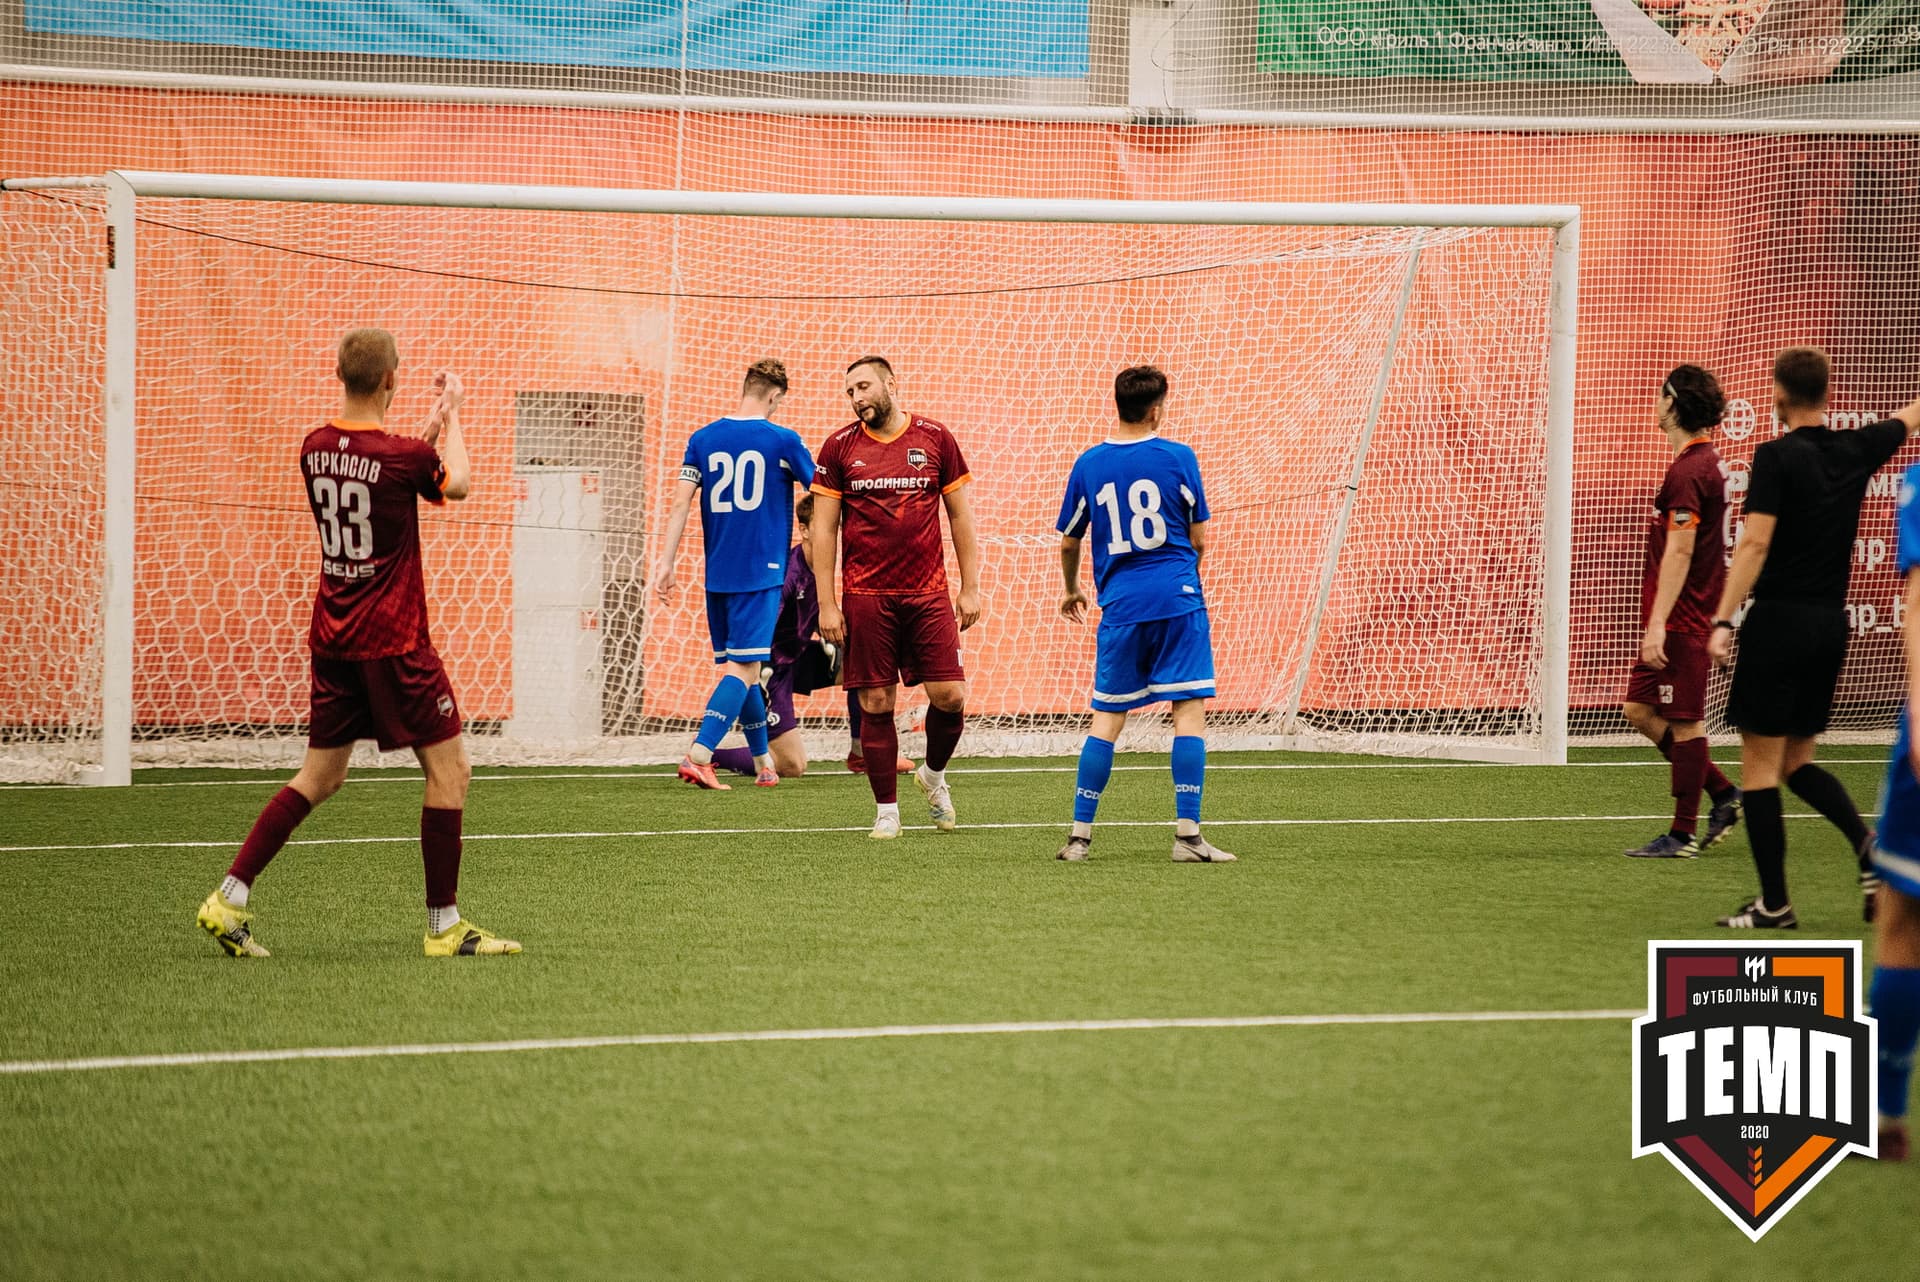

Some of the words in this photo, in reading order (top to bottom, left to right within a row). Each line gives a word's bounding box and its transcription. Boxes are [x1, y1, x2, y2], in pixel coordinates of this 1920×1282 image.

[1318, 26, 1365, 45] ООО
[306, 451, 382, 484] ЧЕРКАСОВ
[708, 450, 766, 513] 20
[850, 477, 931, 491] ПРОДИНВЕСТ
[312, 476, 374, 561] 33
[1095, 478, 1168, 556] 18
[323, 560, 376, 578] SEUS
[1076, 787, 1101, 800] FCD
[1175, 783, 1201, 795] CDM
